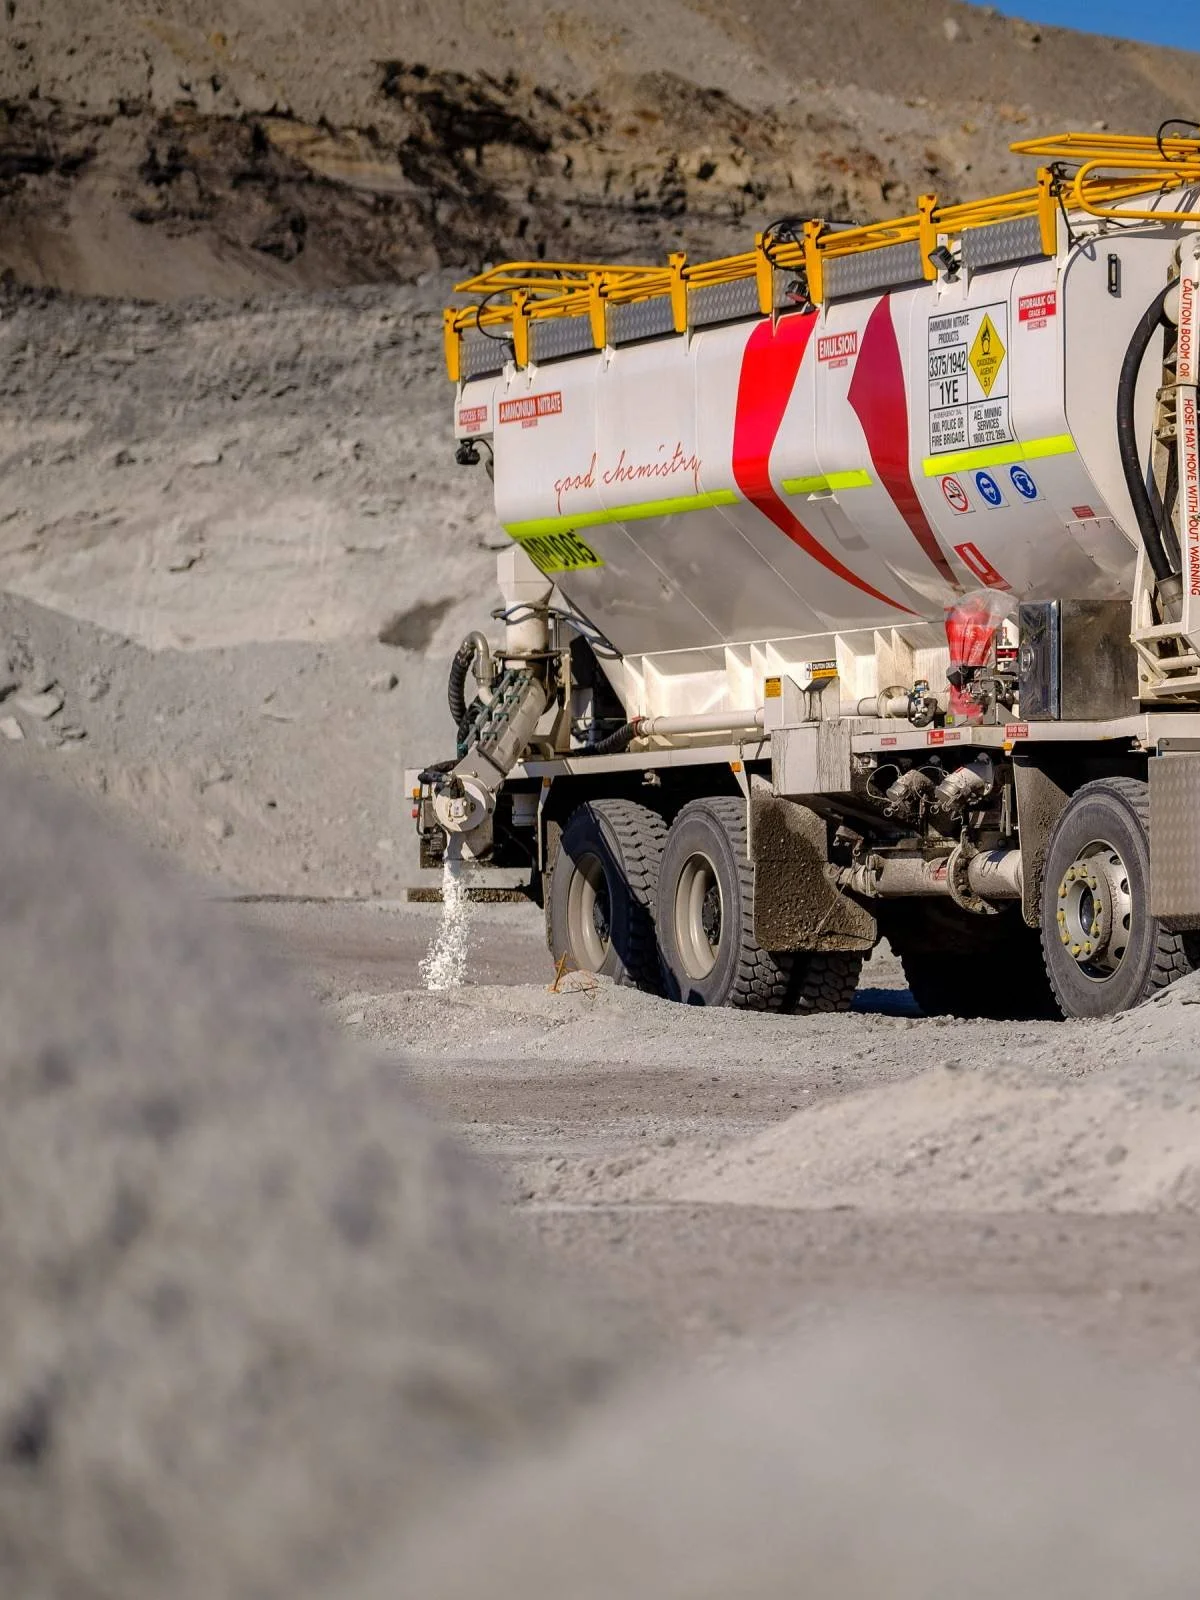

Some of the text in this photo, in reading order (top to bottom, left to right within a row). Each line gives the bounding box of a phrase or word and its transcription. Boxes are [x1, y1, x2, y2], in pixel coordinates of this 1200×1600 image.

[929, 314, 970, 333] AMMONIUM NITRATE
[1179, 278, 1193, 377] CAUTION BOOM OR
[819, 333, 857, 359] EMULSION
[938, 330, 960, 345] PRODUCTS
[929, 350, 967, 379] 3375/1942
[939, 379, 959, 406] 1YE
[500, 393, 561, 422] AMMONIUM NITRATE
[973, 409, 984, 421] AEL
[984, 406, 1002, 419] MINING
[1184, 398, 1195, 426] HOSE
[941, 418, 957, 432] POLICE
[976, 418, 1000, 432] SERVICES
[931, 430, 965, 448] FIRE BRIGADE
[1185, 427, 1196, 450] MAY
[554, 441, 702, 516] good chemistry
[1186, 453, 1197, 481] MOVE
[1190, 546, 1200, 596] WARNING
